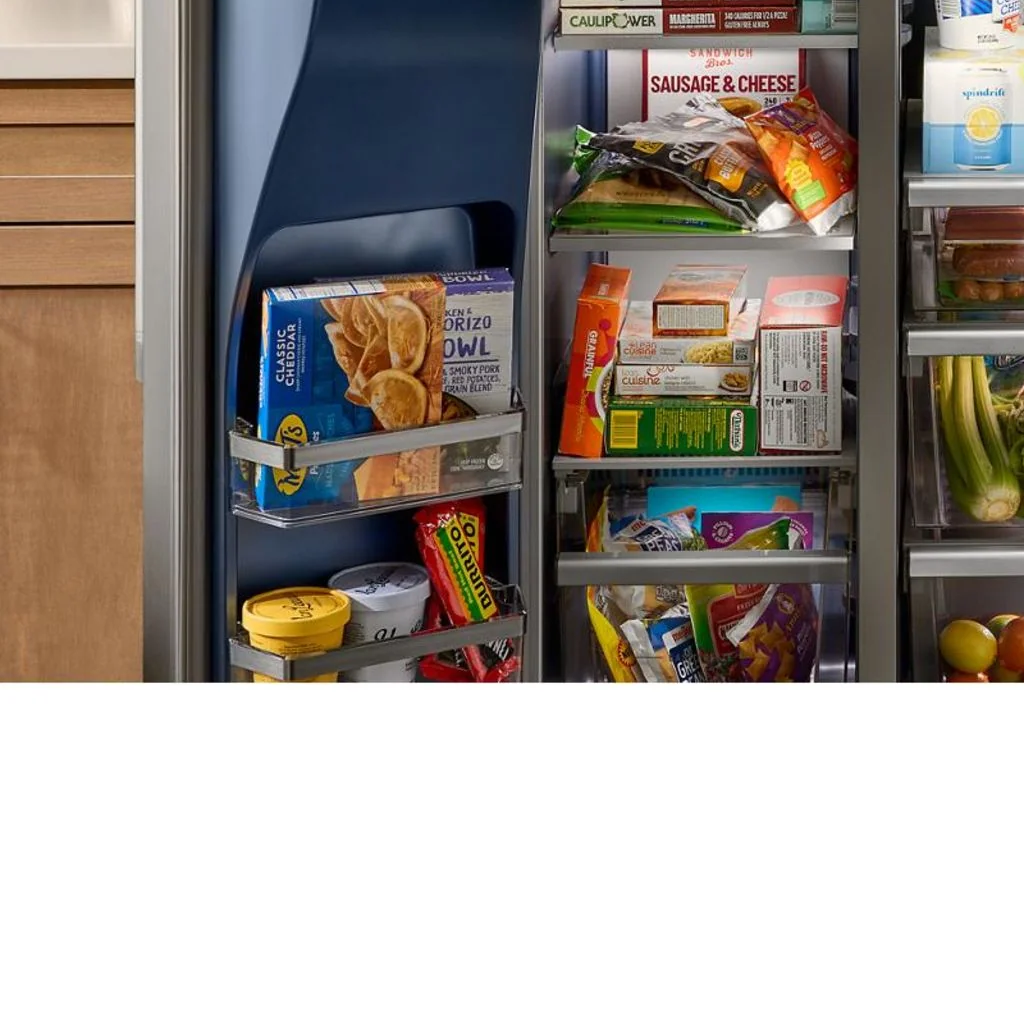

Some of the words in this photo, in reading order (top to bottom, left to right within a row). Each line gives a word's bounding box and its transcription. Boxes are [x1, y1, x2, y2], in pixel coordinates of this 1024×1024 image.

[669, 13, 716, 25] MARGHERITA
[689, 48, 753, 58] SANDWICH
[650, 74, 720, 94] SAUSAGE
[722, 74, 735, 93] &
[738, 74, 796, 93] CHEESE
[961, 87, 1006, 101] spindrift
[442, 274, 494, 283] BOWL
[443, 315, 492, 332] ORIZO
[285, 323, 297, 387] CHEDDAR
[443, 336, 491, 359] OWL
[583, 329, 598, 378] GRAINFUL
[276, 329, 287, 383] CLASSIC
[449, 366, 481, 376] SMOKY
[480, 365, 500, 375] PORK
[469, 383, 493, 393] BLEND
[621, 376, 661, 386] cuisine
[450, 526, 492, 610] BURRITO
